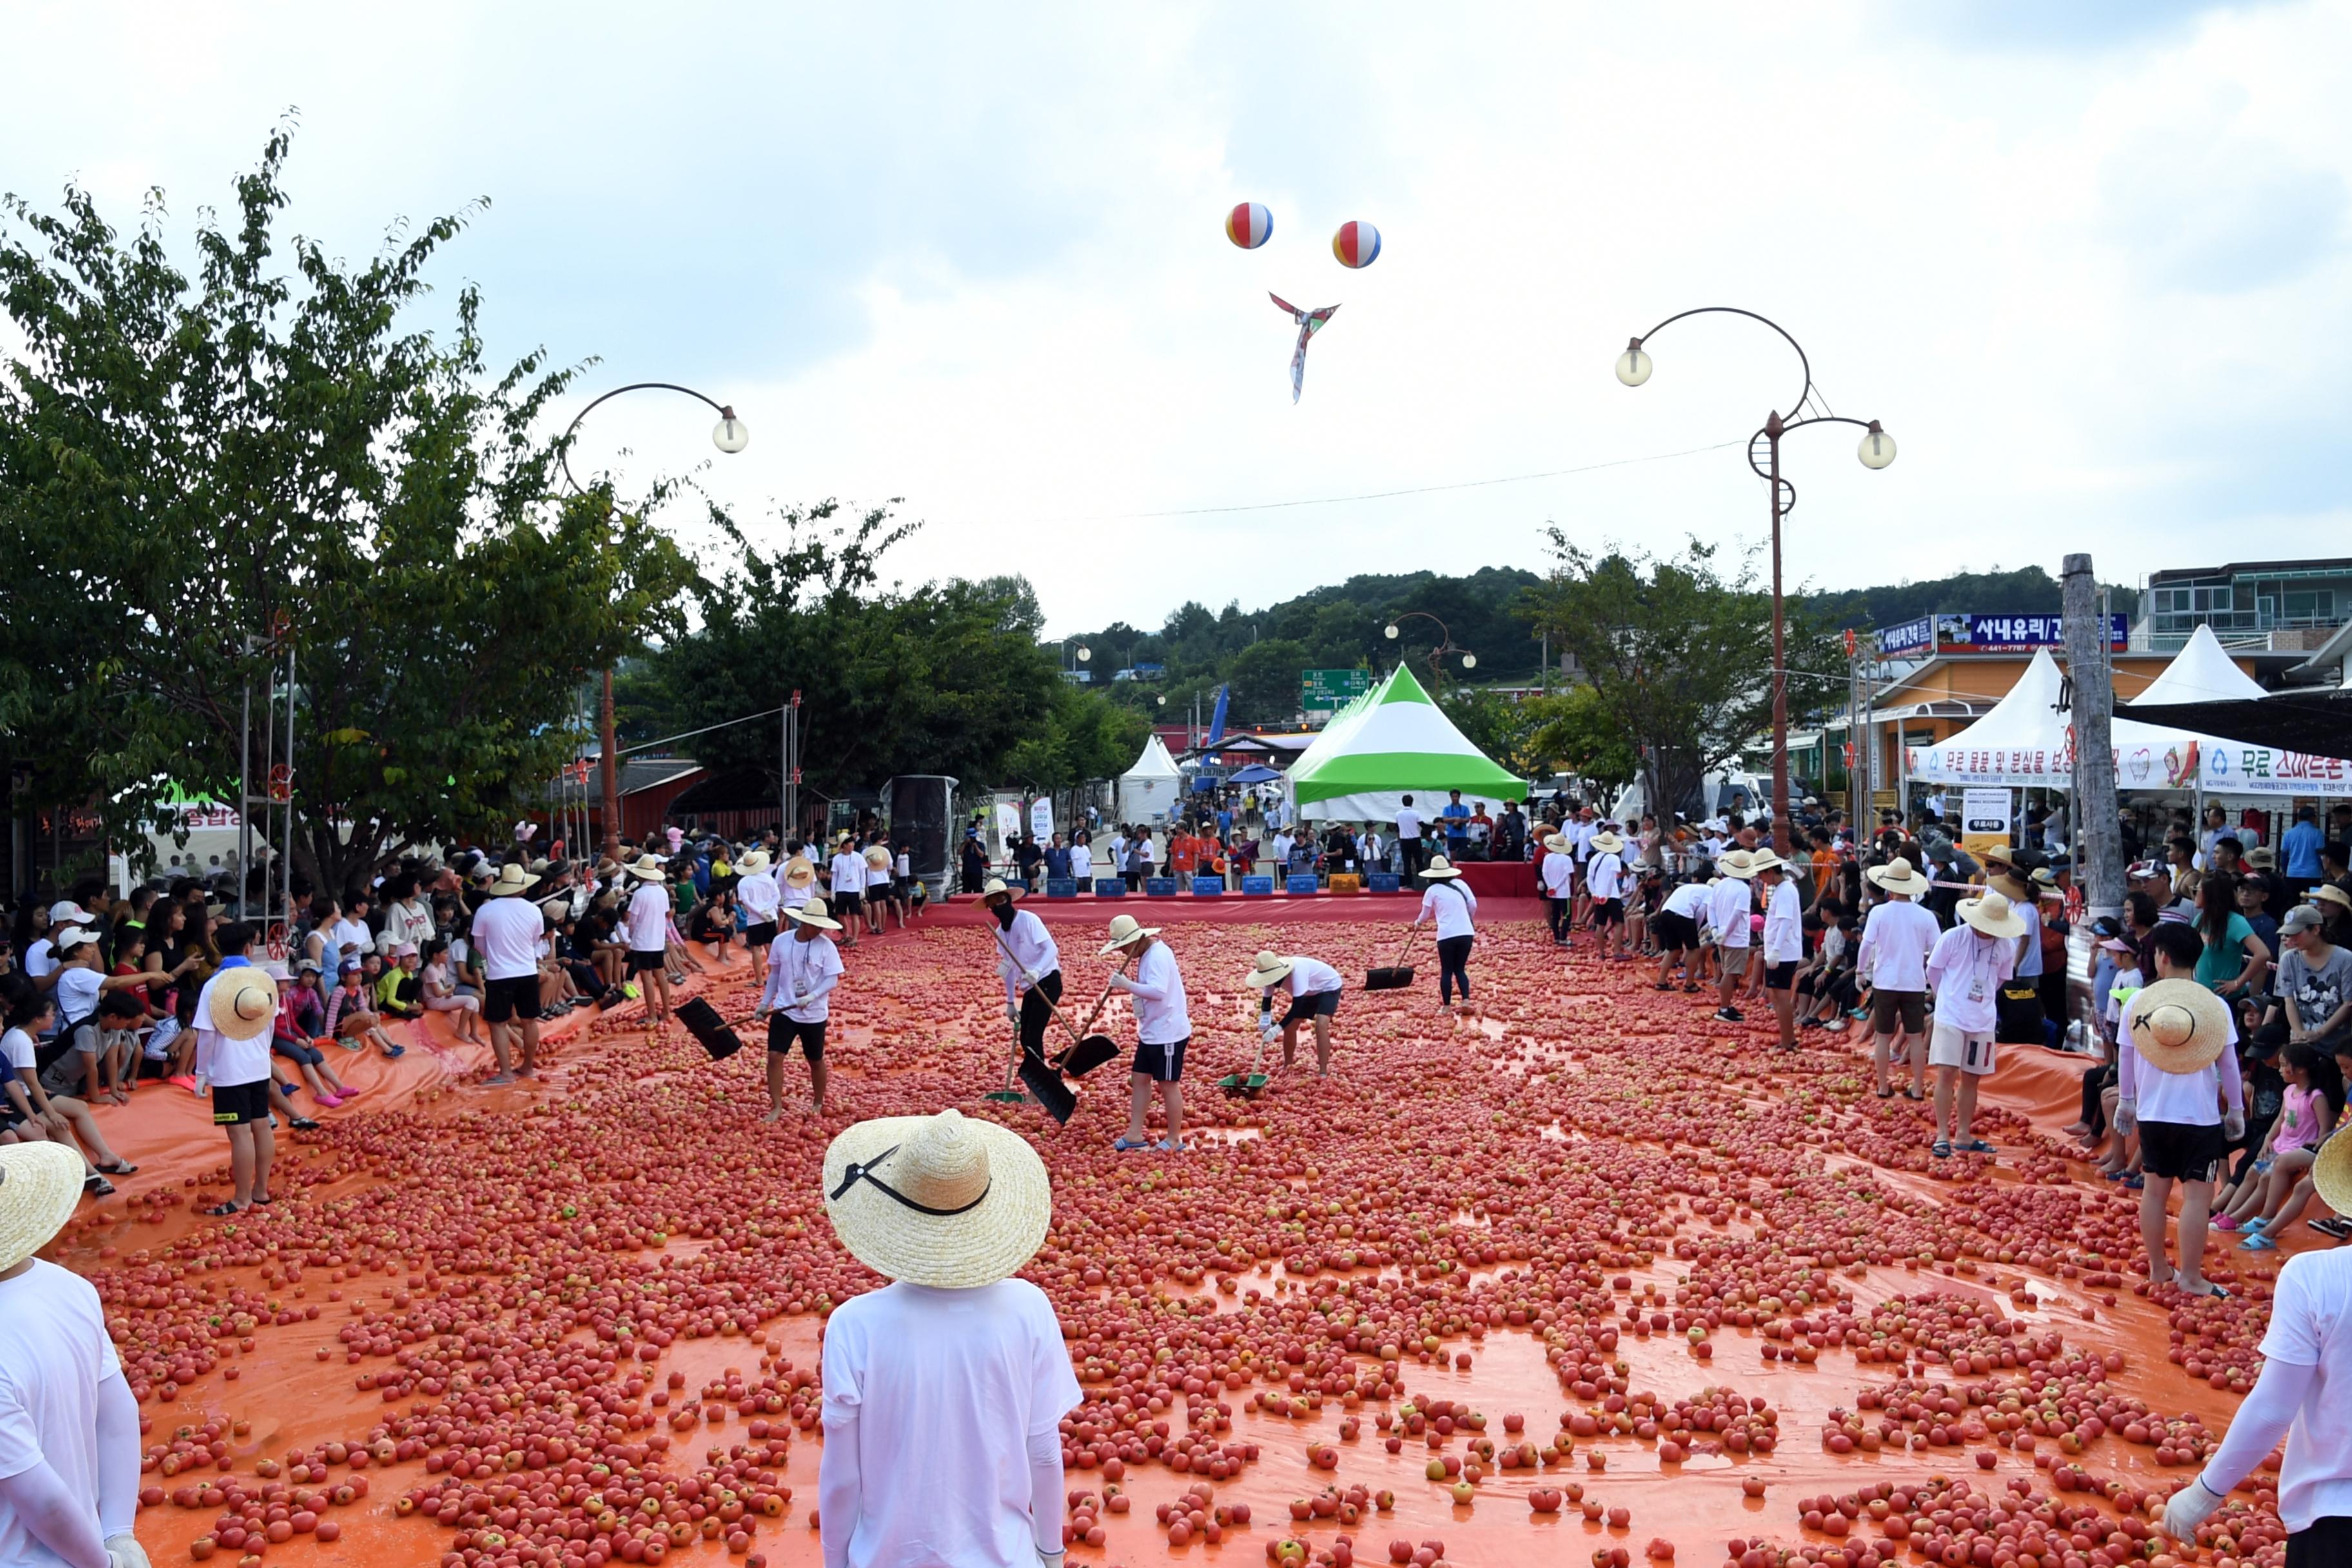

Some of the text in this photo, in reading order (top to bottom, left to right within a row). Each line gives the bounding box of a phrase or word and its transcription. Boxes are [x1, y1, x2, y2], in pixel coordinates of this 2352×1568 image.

[1946, 751, 1964, 772] 무료
[1970, 751, 1989, 773] 물품
[1995, 751, 2004, 774] 및
[2011, 751, 2044, 774] 분실물
[2241, 750, 2343, 780] 무료 스마트폰
